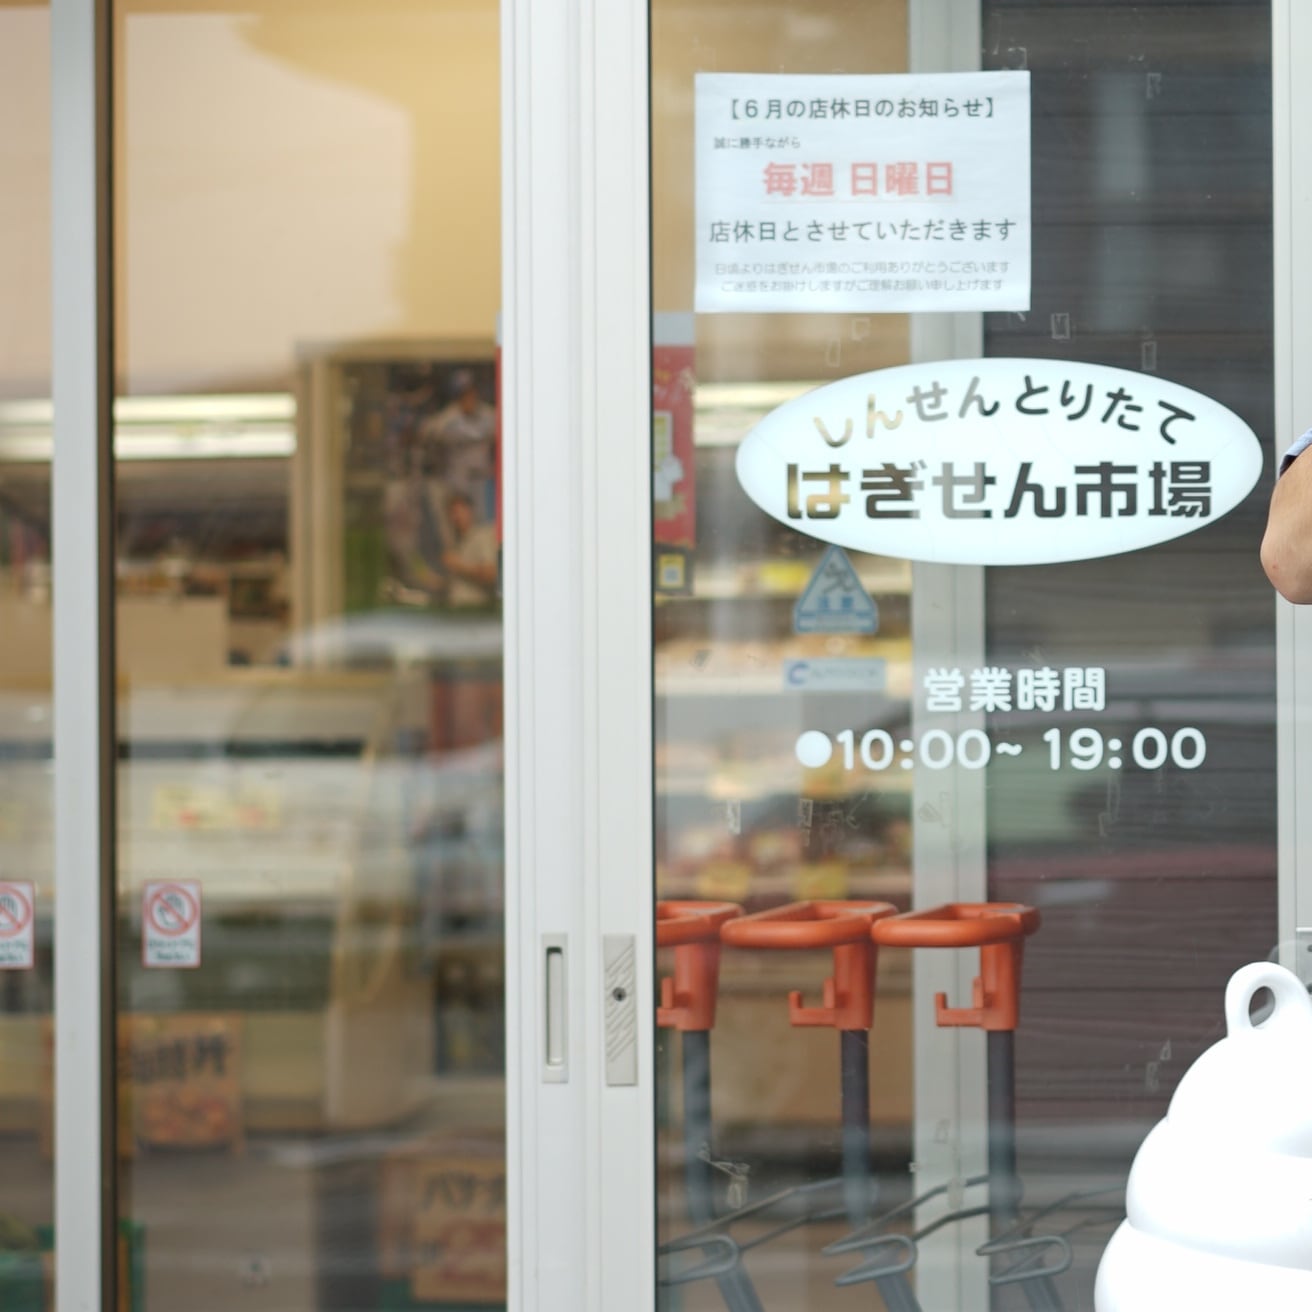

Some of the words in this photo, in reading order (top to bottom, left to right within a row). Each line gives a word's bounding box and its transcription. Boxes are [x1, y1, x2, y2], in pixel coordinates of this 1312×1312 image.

[762, 161, 835, 197] 毎週
[850, 161, 954, 197] 日曜日
[709, 217, 1016, 244] 店休日とさせていただきます
[814, 375, 1197, 448] しんせんとりたて
[785, 461, 1213, 520] はぎせん市場
[923, 667, 1106, 712] 営業時間
